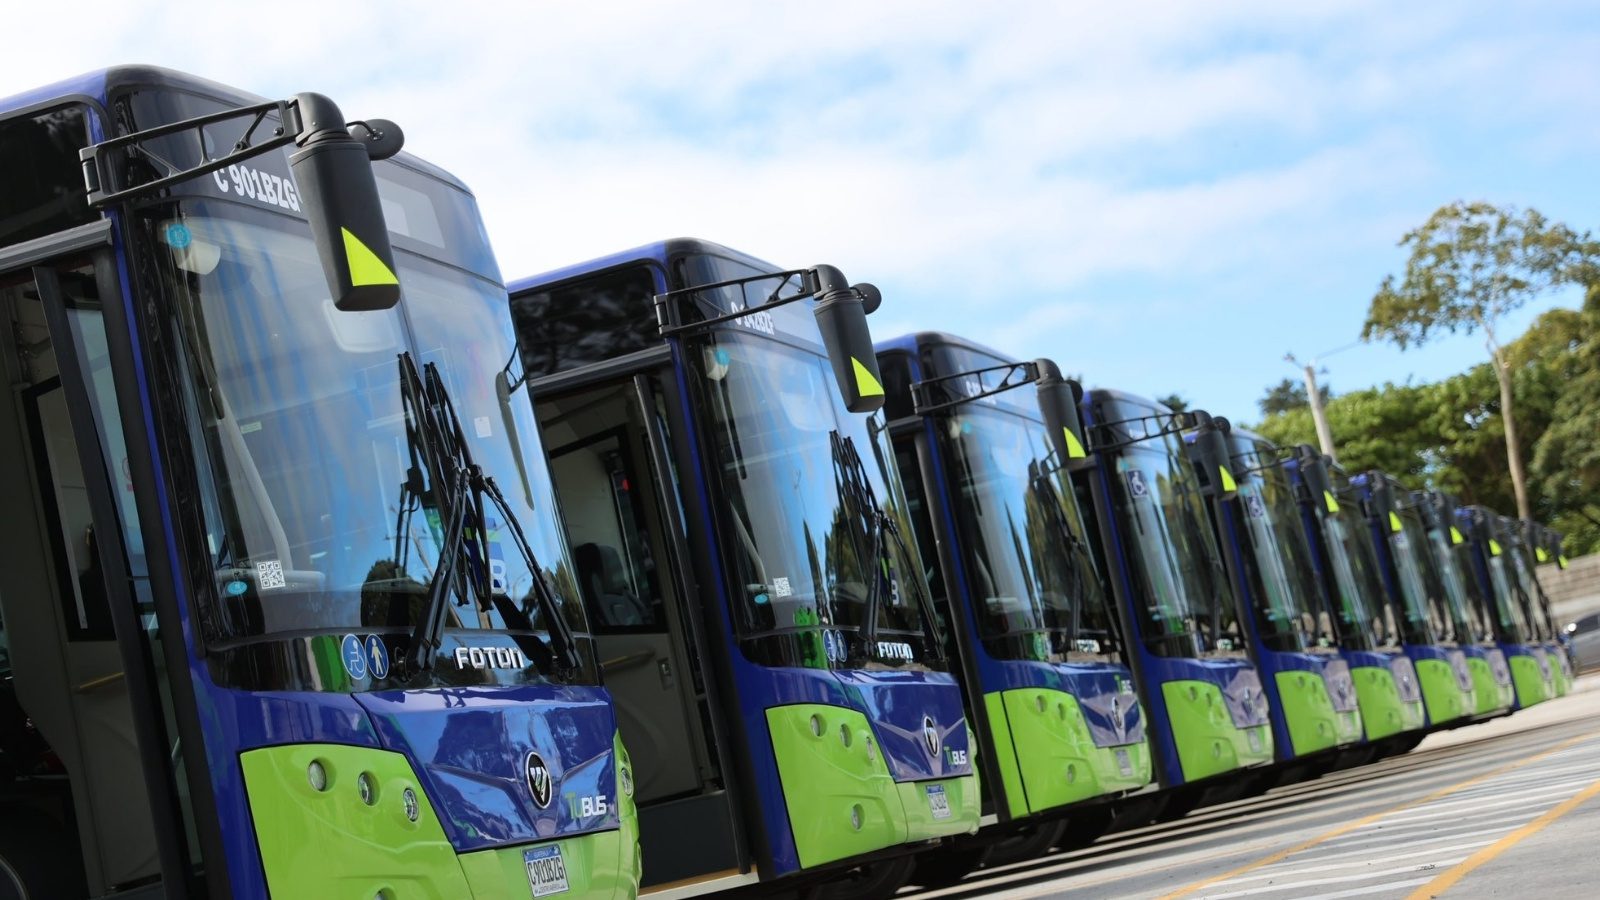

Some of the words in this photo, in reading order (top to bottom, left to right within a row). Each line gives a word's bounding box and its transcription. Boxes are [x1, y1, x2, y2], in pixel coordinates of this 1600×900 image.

[229, 164, 301, 212] 901BZG
[455, 646, 525, 670] FOTON
[877, 641, 914, 660] FOTON
[527, 856, 565, 886] C901BZG
